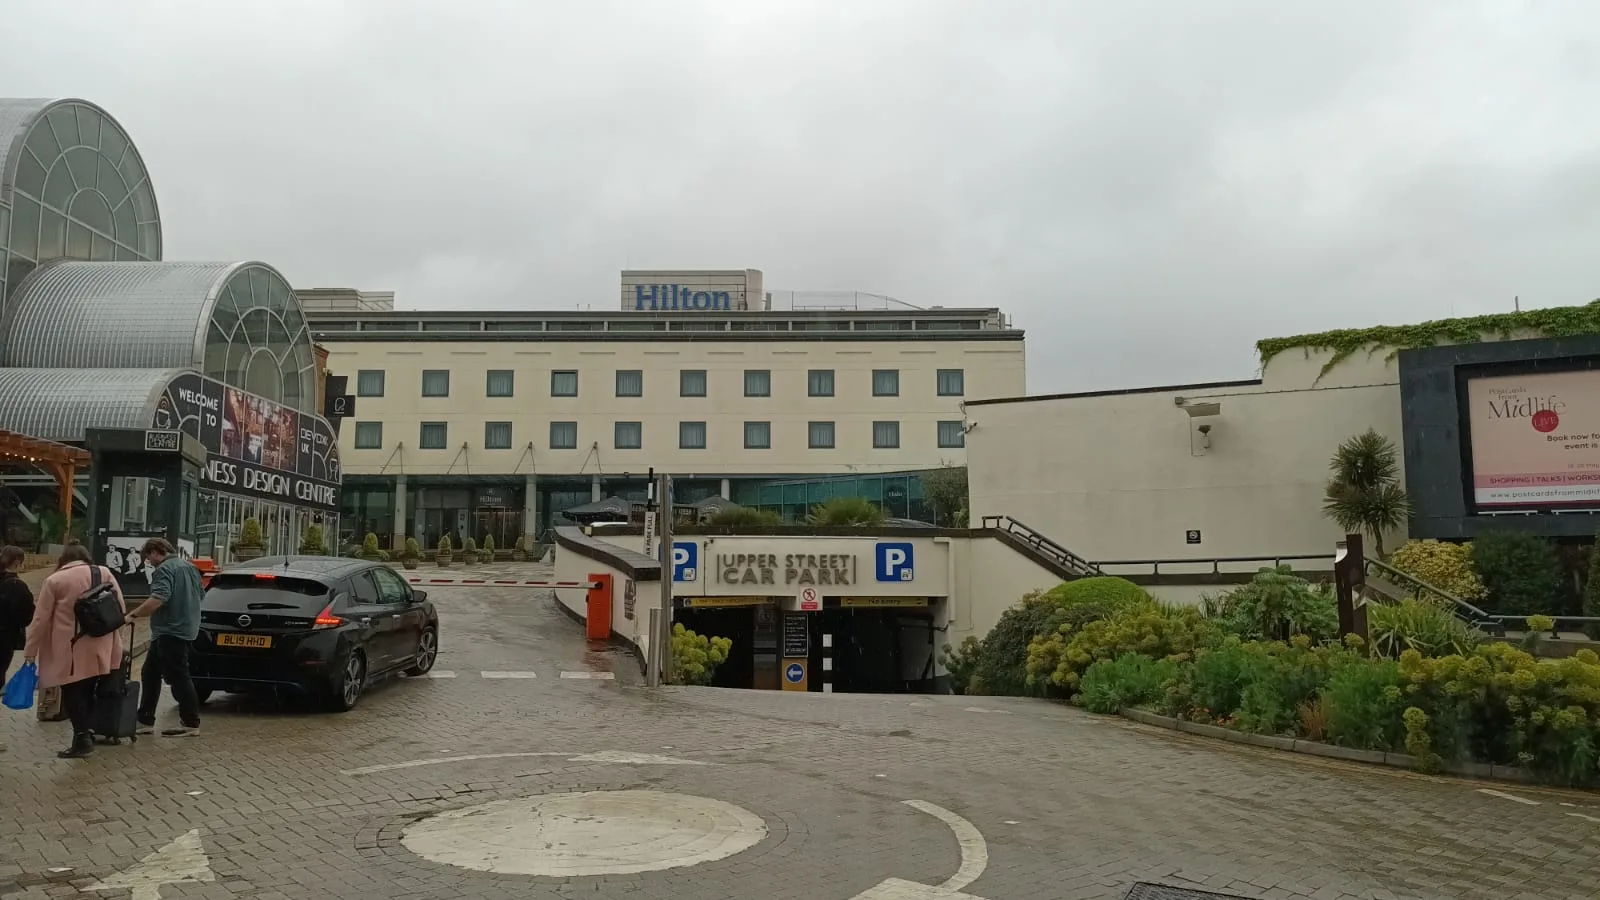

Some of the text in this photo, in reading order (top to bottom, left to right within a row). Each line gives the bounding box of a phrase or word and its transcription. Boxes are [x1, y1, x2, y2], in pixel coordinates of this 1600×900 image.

[635, 284, 731, 311] Hilton
[179, 388, 219, 411] WELCOME
[1488, 395, 1566, 419] Midlife
[206, 413, 217, 427] TO
[301, 443, 310, 454] UK
[201, 460, 337, 506] NESS DESIGN CENTRE
[1536, 475, 1561, 483] TALKS
[674, 548, 689, 576] P
[723, 554, 850, 569] UPPER STREET
[885, 549, 906, 576] P
[723, 568, 850, 585] CAR PARK
[224, 634, 244, 645] BL19
